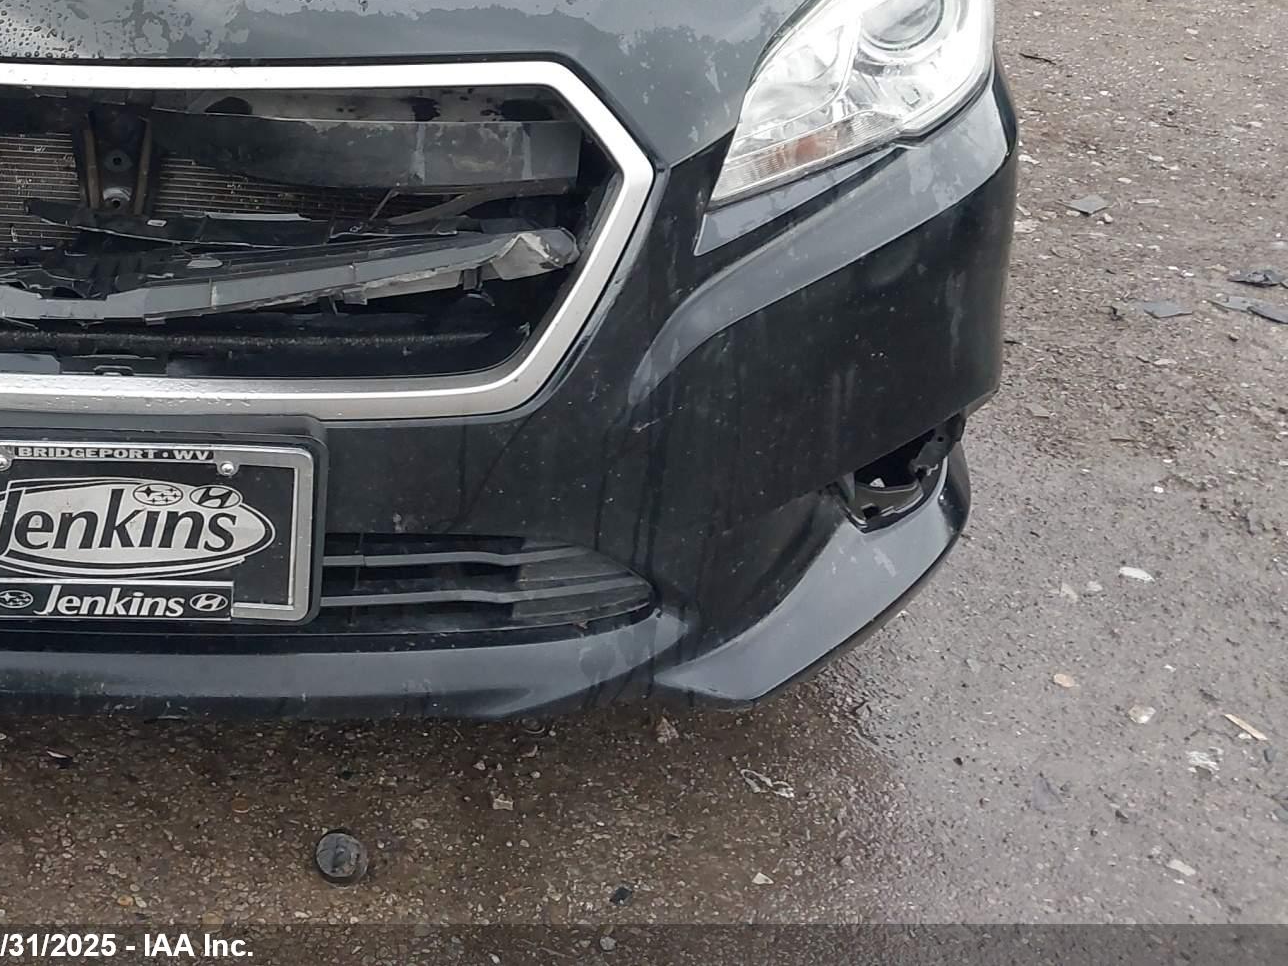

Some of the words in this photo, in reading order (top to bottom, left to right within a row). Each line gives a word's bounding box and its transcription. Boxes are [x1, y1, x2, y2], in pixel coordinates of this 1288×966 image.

[18, 446, 158, 459] BRIDGEPORT
[177, 449, 211, 461] WV
[33, 584, 185, 617] Jenkins
